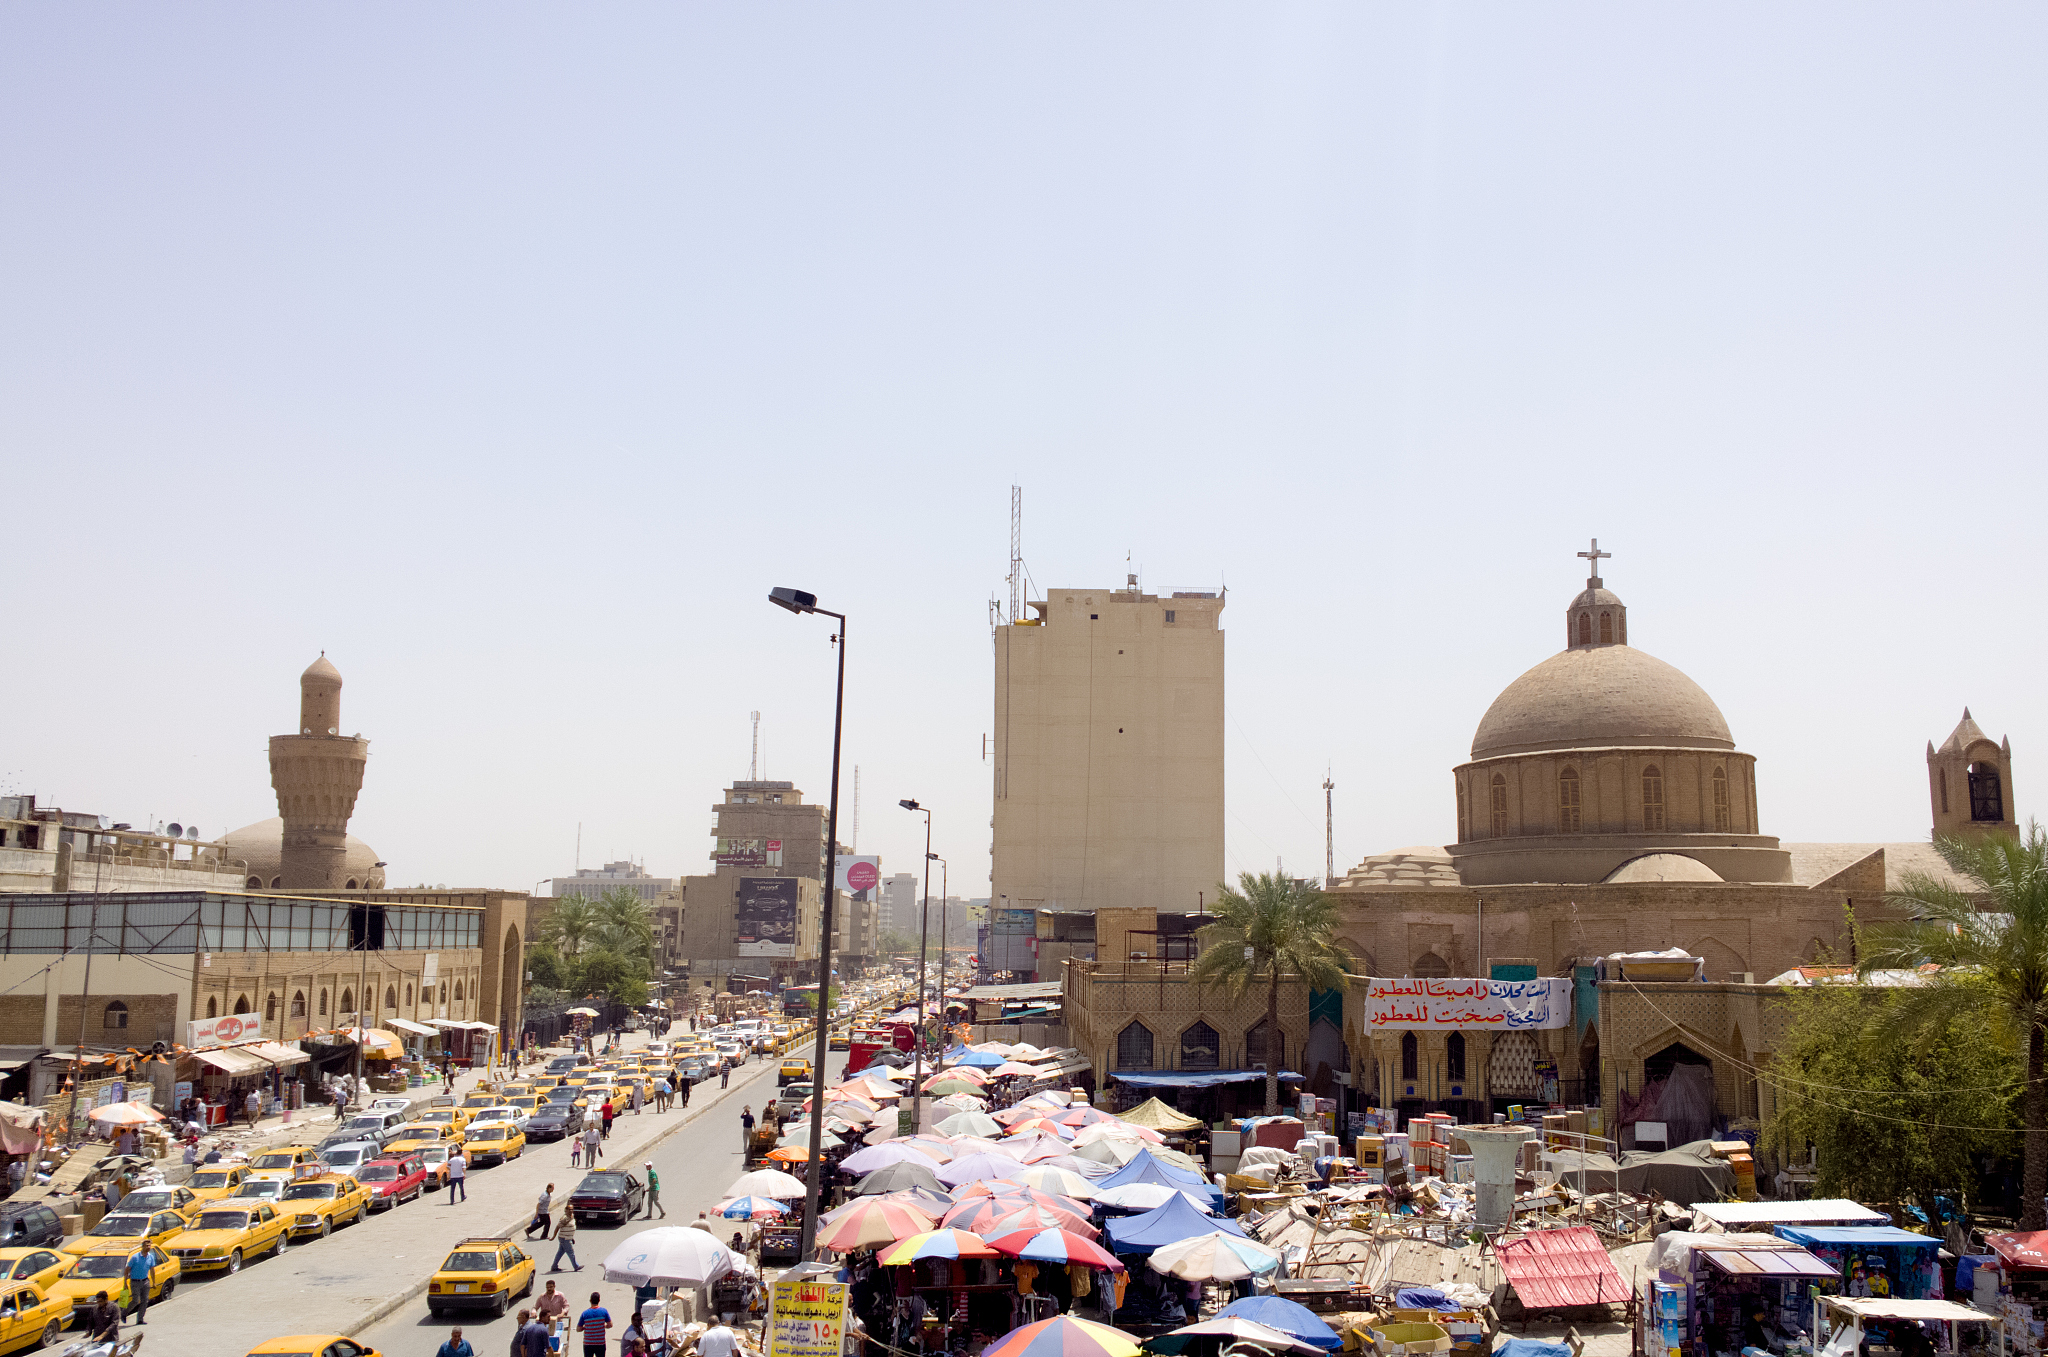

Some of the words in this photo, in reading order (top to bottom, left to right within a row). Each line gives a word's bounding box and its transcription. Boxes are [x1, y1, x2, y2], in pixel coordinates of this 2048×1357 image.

[1369, 980, 1423, 999] للعطور
[1490, 982, 1525, 998] محلات
[1371, 1003, 1428, 1025] للعطور
[827, 1296, 842, 1305] شركة
[813, 1322, 839, 1339] ١٥٠
